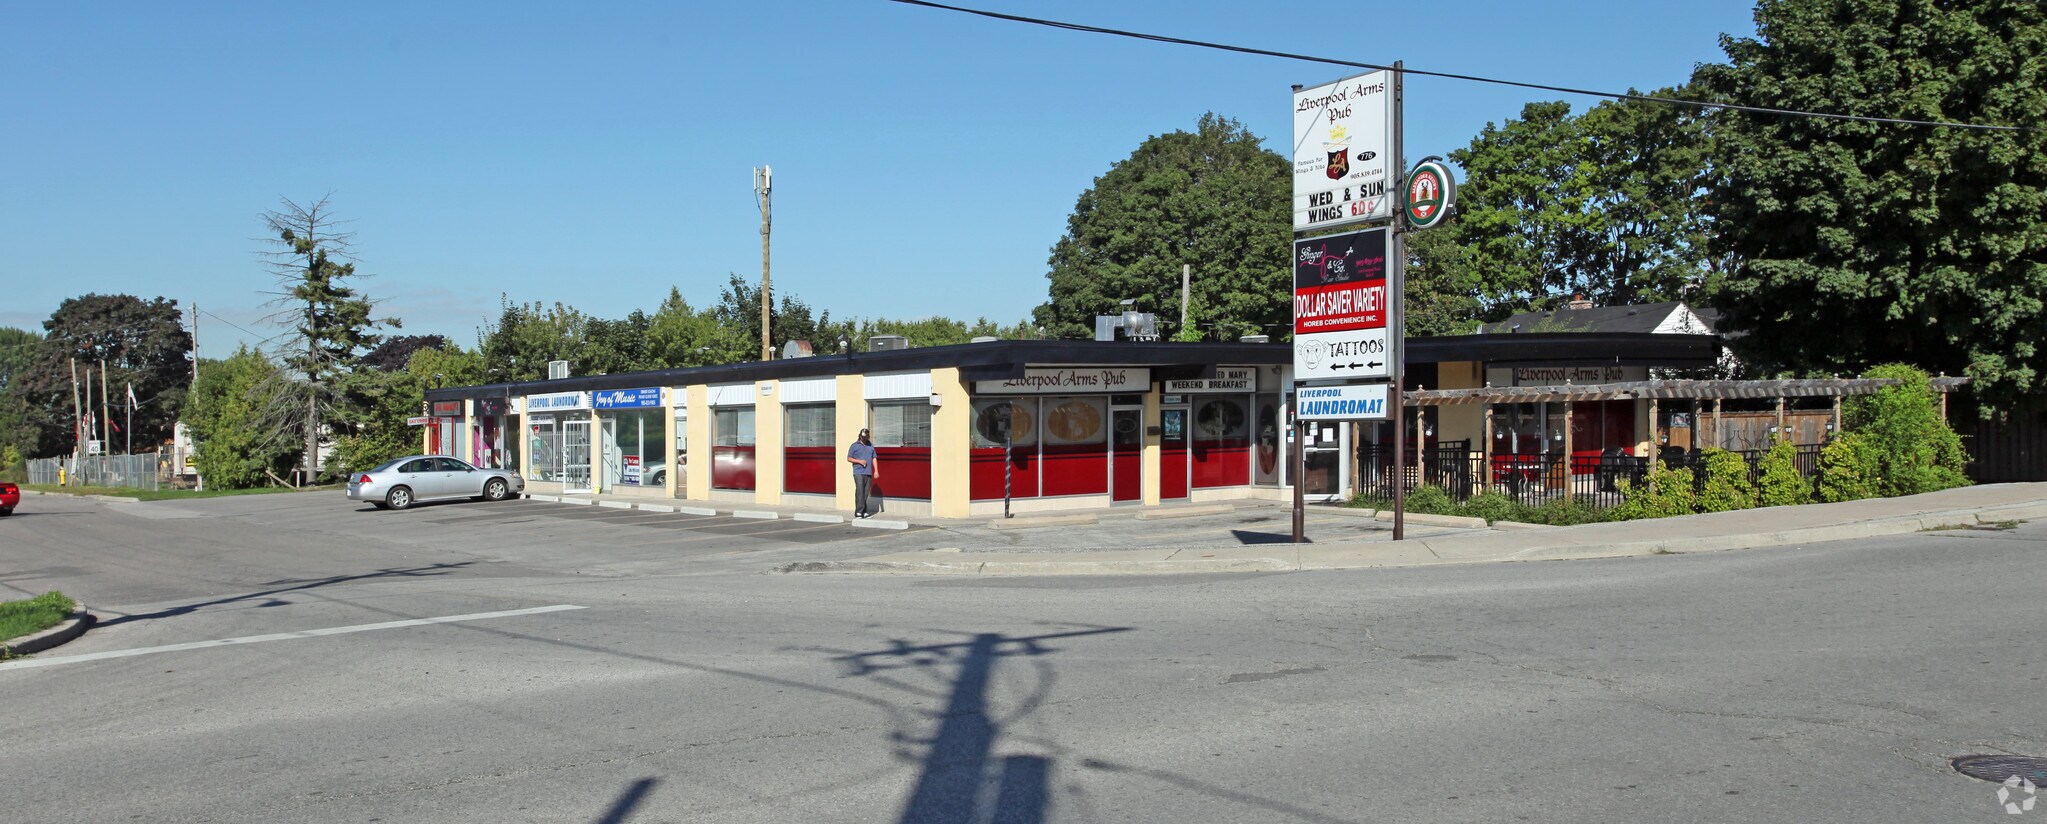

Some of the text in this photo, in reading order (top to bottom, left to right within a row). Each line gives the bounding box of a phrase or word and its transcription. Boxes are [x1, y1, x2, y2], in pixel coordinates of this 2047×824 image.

[1296, 83, 1384, 113] Liverpool Arms
[1326, 104, 1352, 125] Pub
[1360, 152, 1373, 160] 776
[1309, 180, 1384, 208] WED & SUN
[1308, 205, 1343, 224] WINGS
[1297, 286, 1385, 319] DOLLAR SAVER VARIETY
[1304, 320, 1324, 328] HOREB
[1324, 316, 1365, 326] CONVENIENCE
[1327, 338, 1384, 358] TATTOOS
[1063, 371, 1098, 387] Arms
[1101, 370, 1126, 389] Pub
[1229, 371, 1248, 379] MARY
[1518, 366, 1624, 386] Liverpool Arms Pub
[1172, 381, 1248, 389] WEEKEND BREAKFAST
[1300, 389, 1342, 398] LIVERPOOL
[529, 394, 580, 408] LIVERPOOL LAUNDROMAT
[596, 391, 637, 407] Joy of Music
[1300, 399, 1384, 415] LAUNDROMAT
